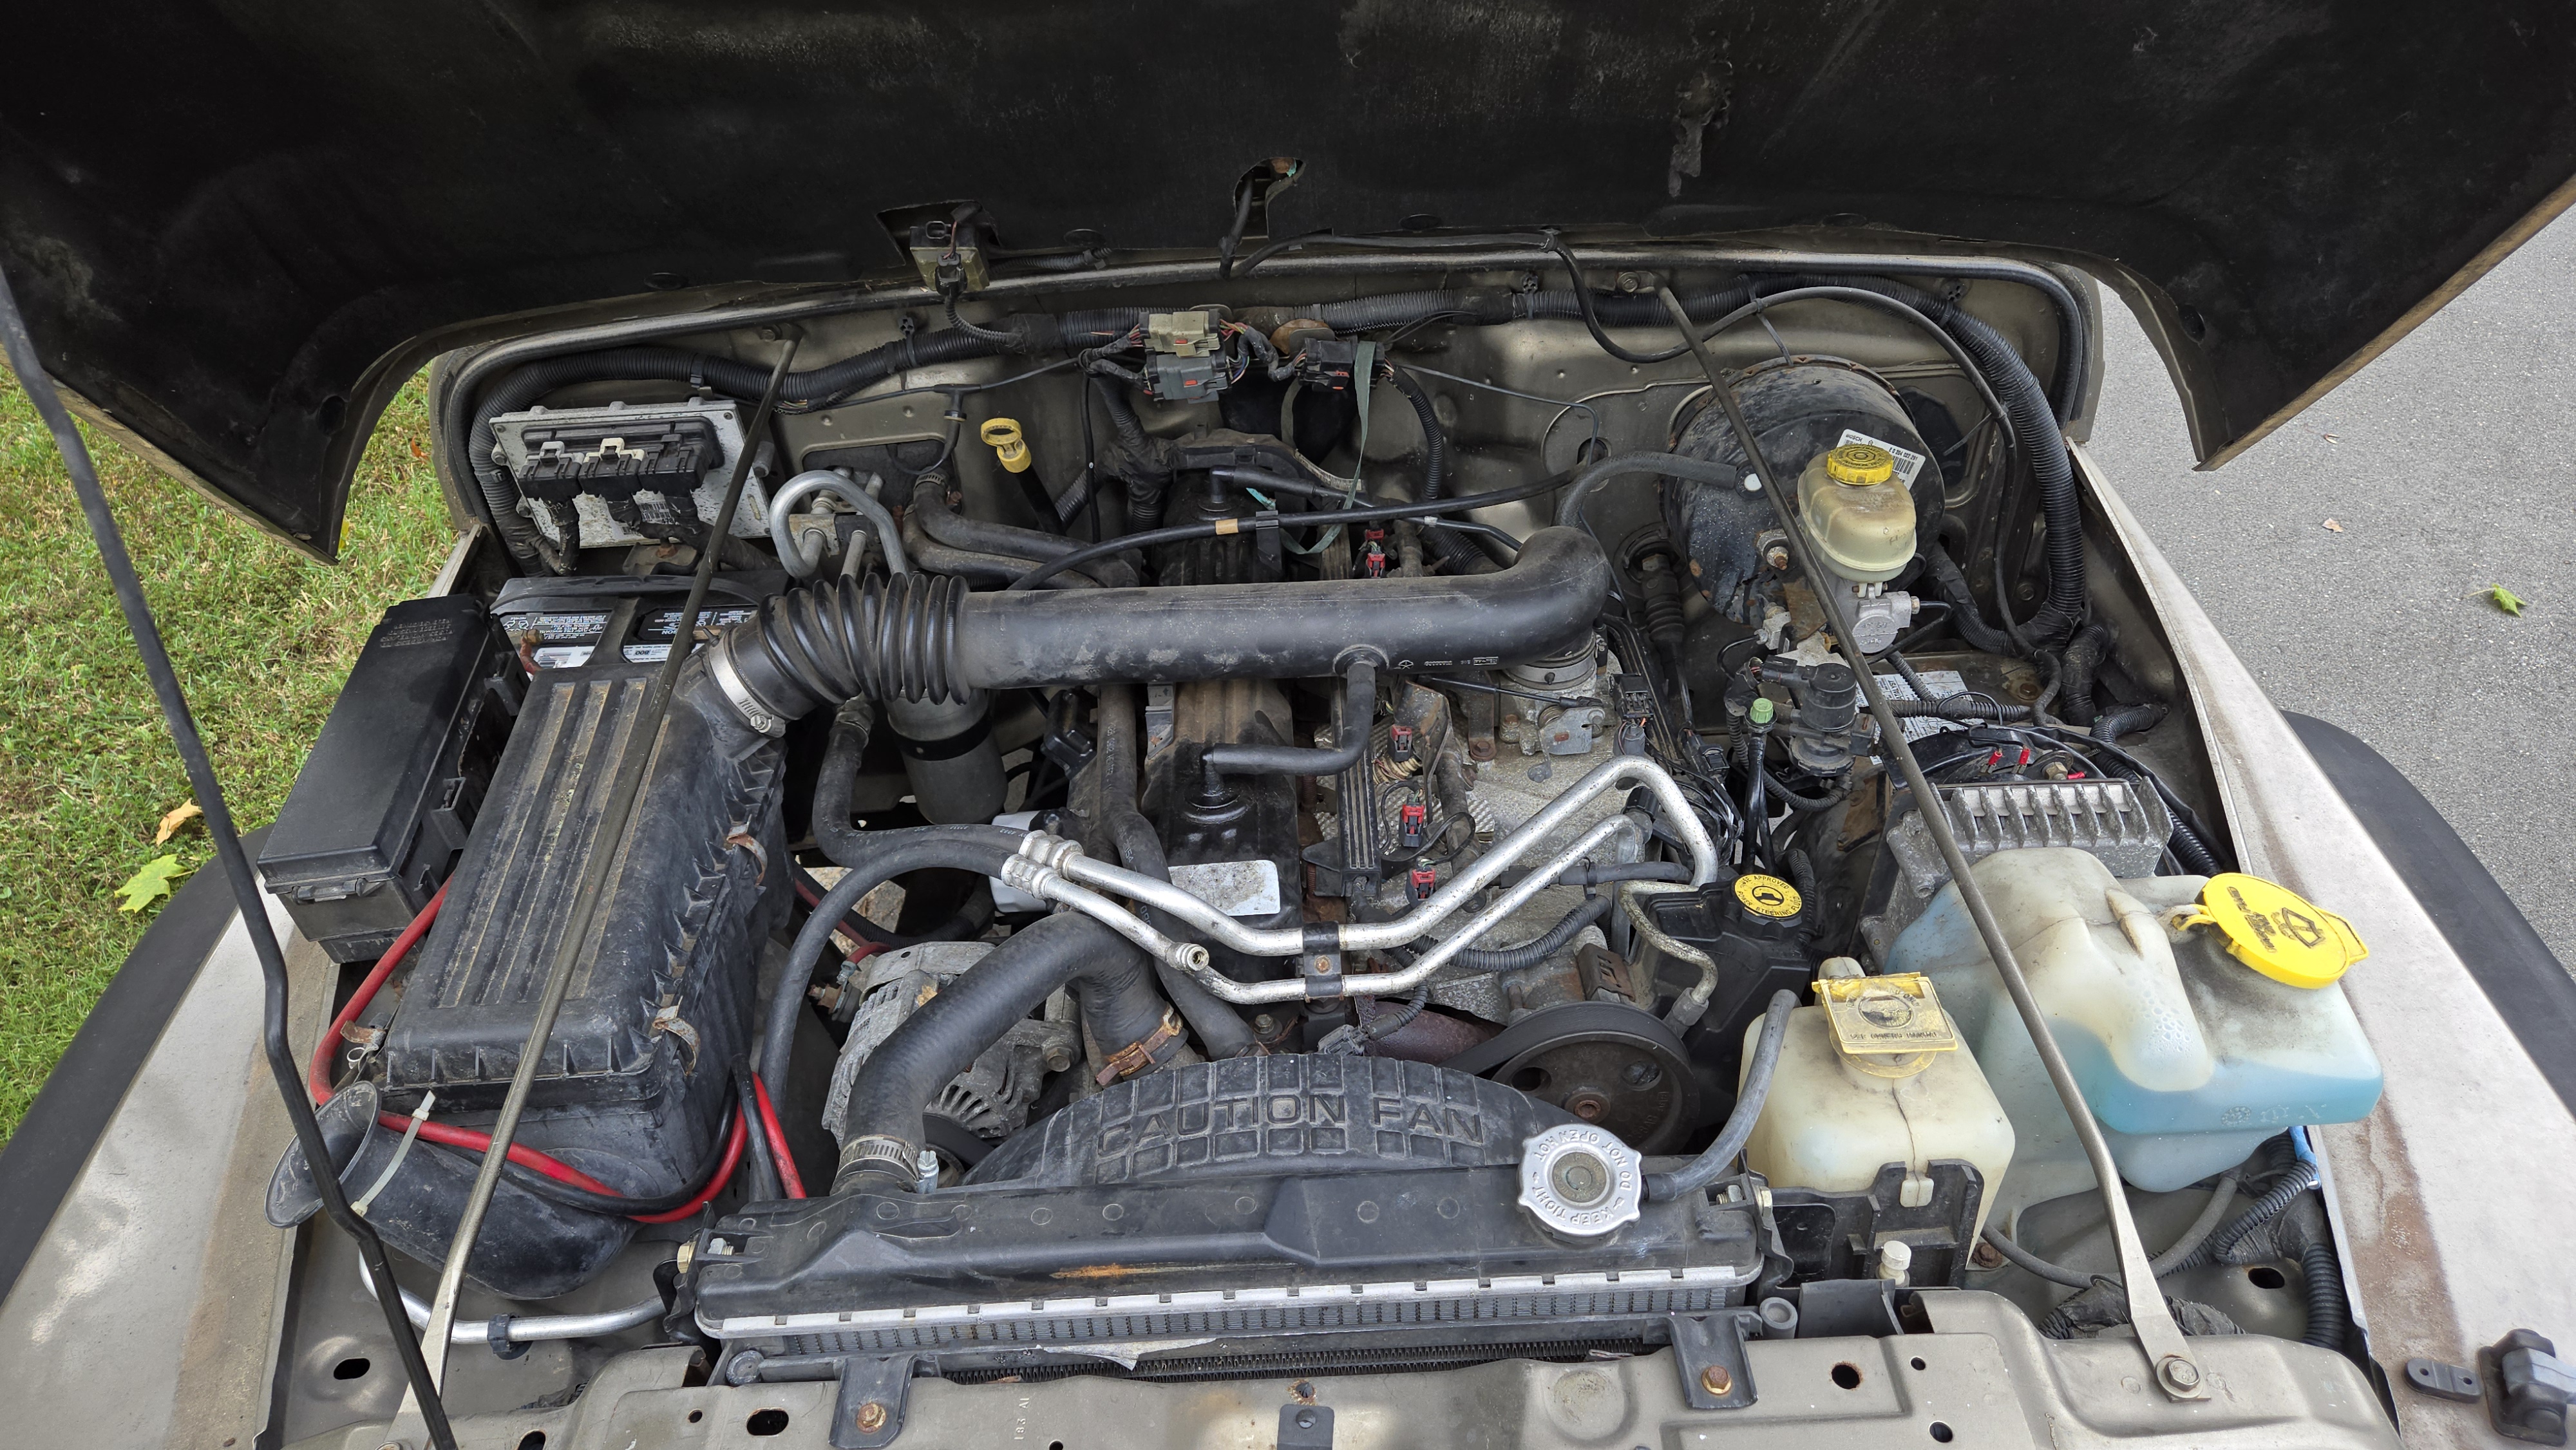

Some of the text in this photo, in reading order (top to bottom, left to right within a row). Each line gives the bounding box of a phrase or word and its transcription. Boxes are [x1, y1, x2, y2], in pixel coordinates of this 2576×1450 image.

[1754, 876, 1789, 889] APPROVED
[1738, 890, 1801, 916] POWER STEERING FLUID
[1097, 1095, 1483, 1156] CAUTION FAN
[1534, 1129, 1633, 1191] DO NOT OPEN HOT
[1532, 1187, 1614, 1225] KEEP TIGHT
